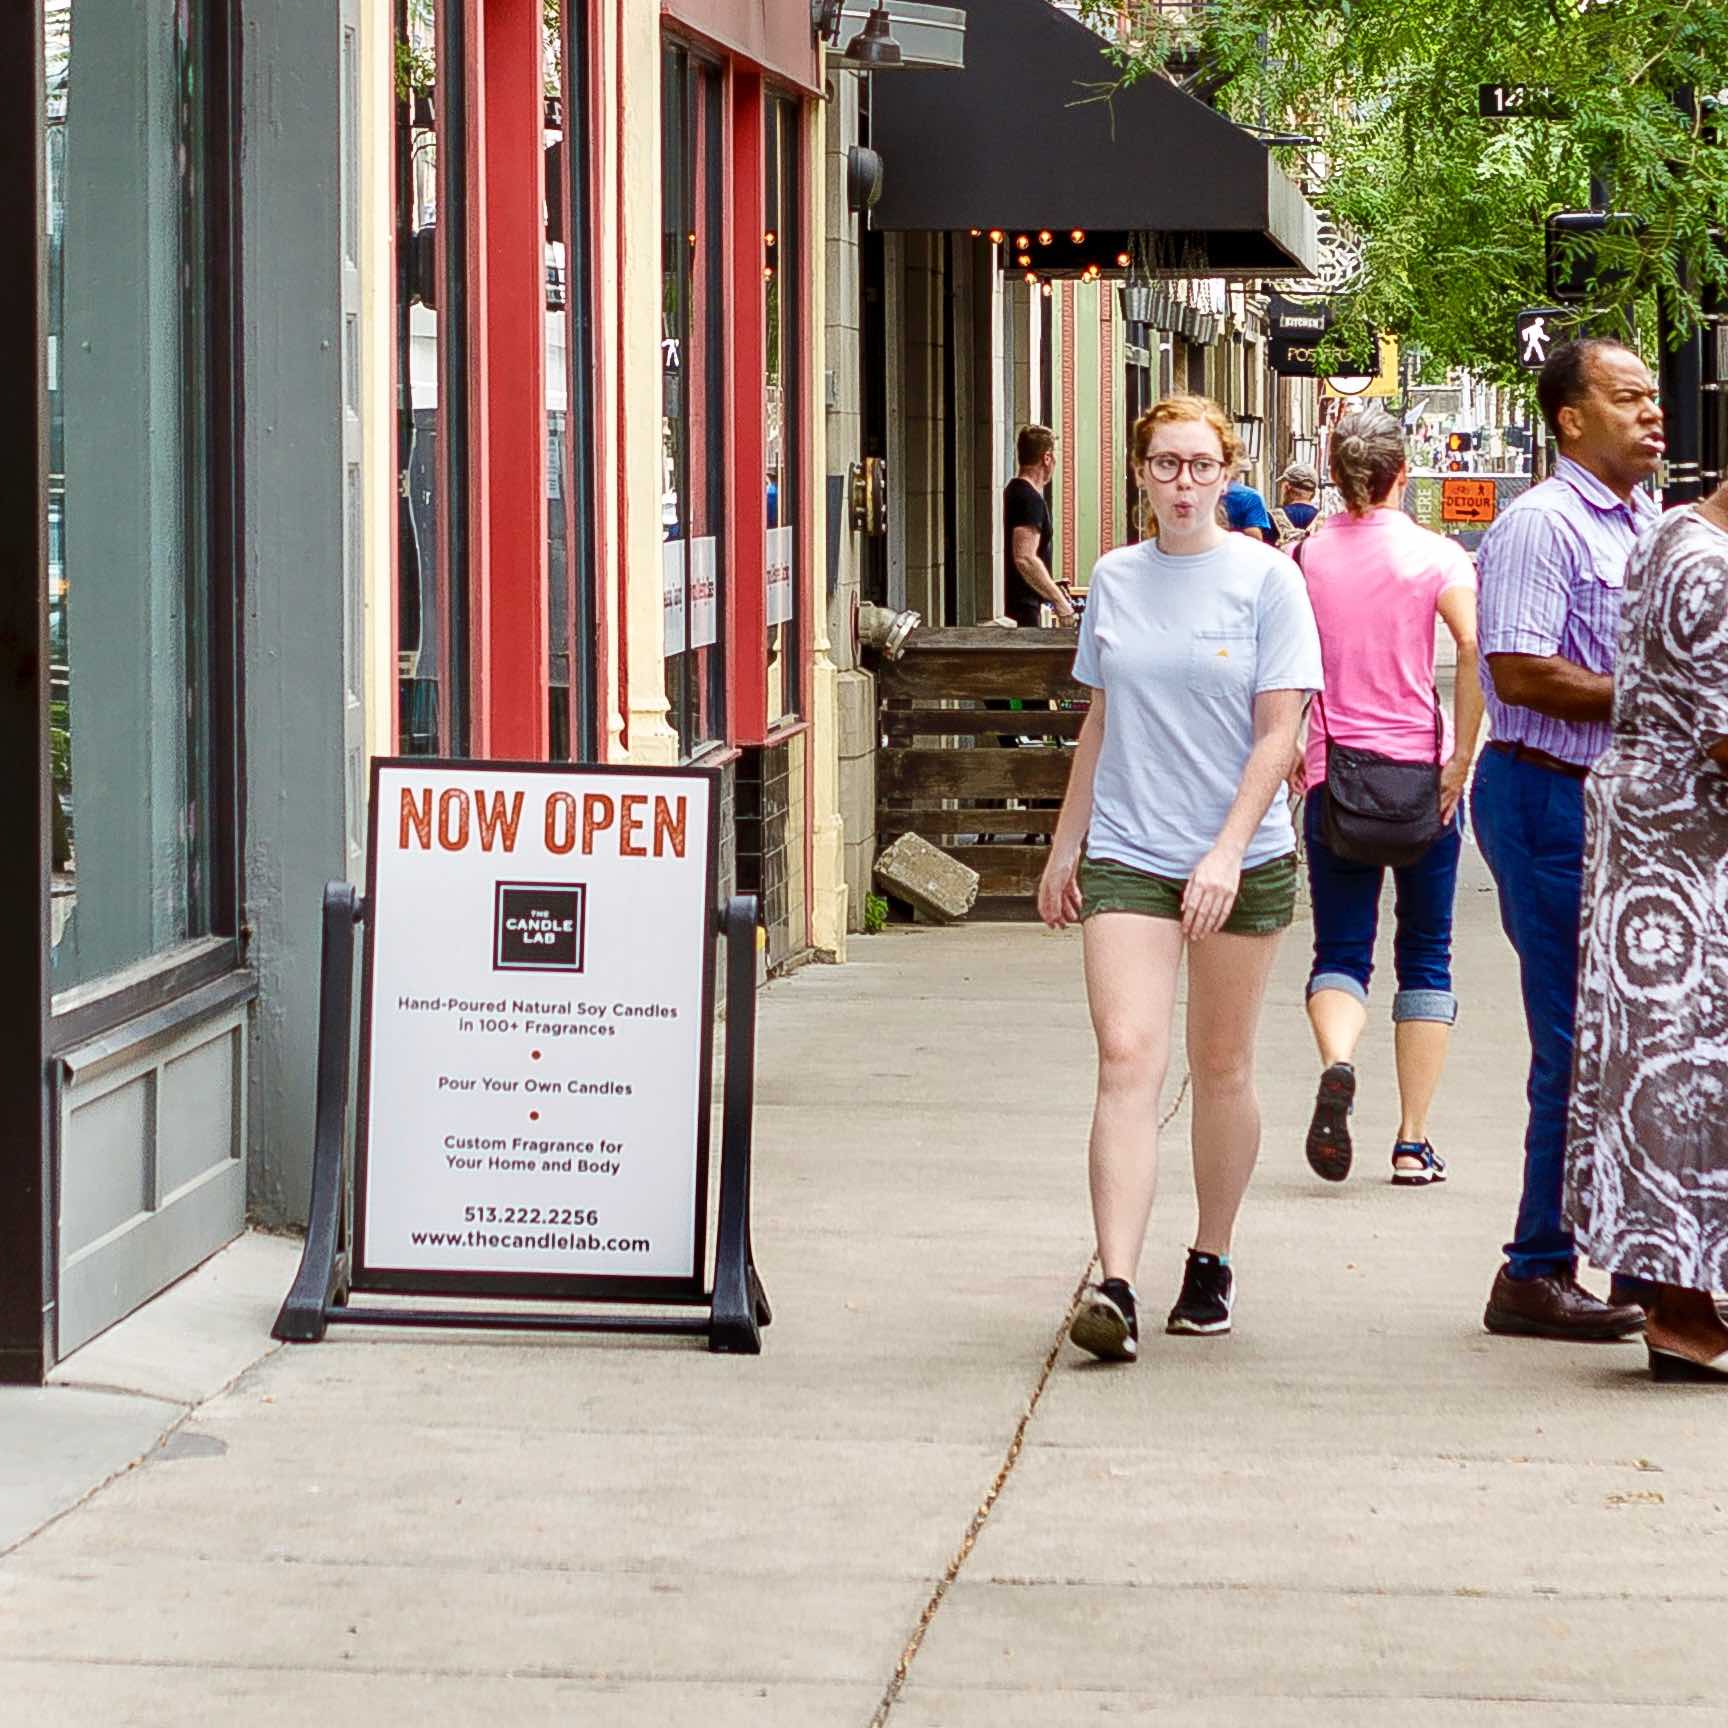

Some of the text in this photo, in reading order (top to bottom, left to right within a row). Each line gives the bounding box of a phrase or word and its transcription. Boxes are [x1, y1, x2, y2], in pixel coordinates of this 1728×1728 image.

[1446, 496, 1491, 508] DETOUR
[398, 787, 688, 858] NOW OPEN
[530, 909, 550, 919] THE
[505, 918, 574, 932] CANDLE
[522, 932, 556, 945] LAB
[398, 996, 678, 1019] Hand-Poured Natural Soy Candles
[479, 1019, 518, 1033] 100+
[525, 1020, 616, 1036] Fragrances
[438, 1076, 633, 1096] Pour Your Own Candles
[444, 1135, 624, 1155] Custom Fragrance for
[446, 1155, 621, 1177] Your Home and Body
[464, 1205, 599, 1227] 513.222.2256
[411, 1229, 651, 1254] www.thecandlelab.com
